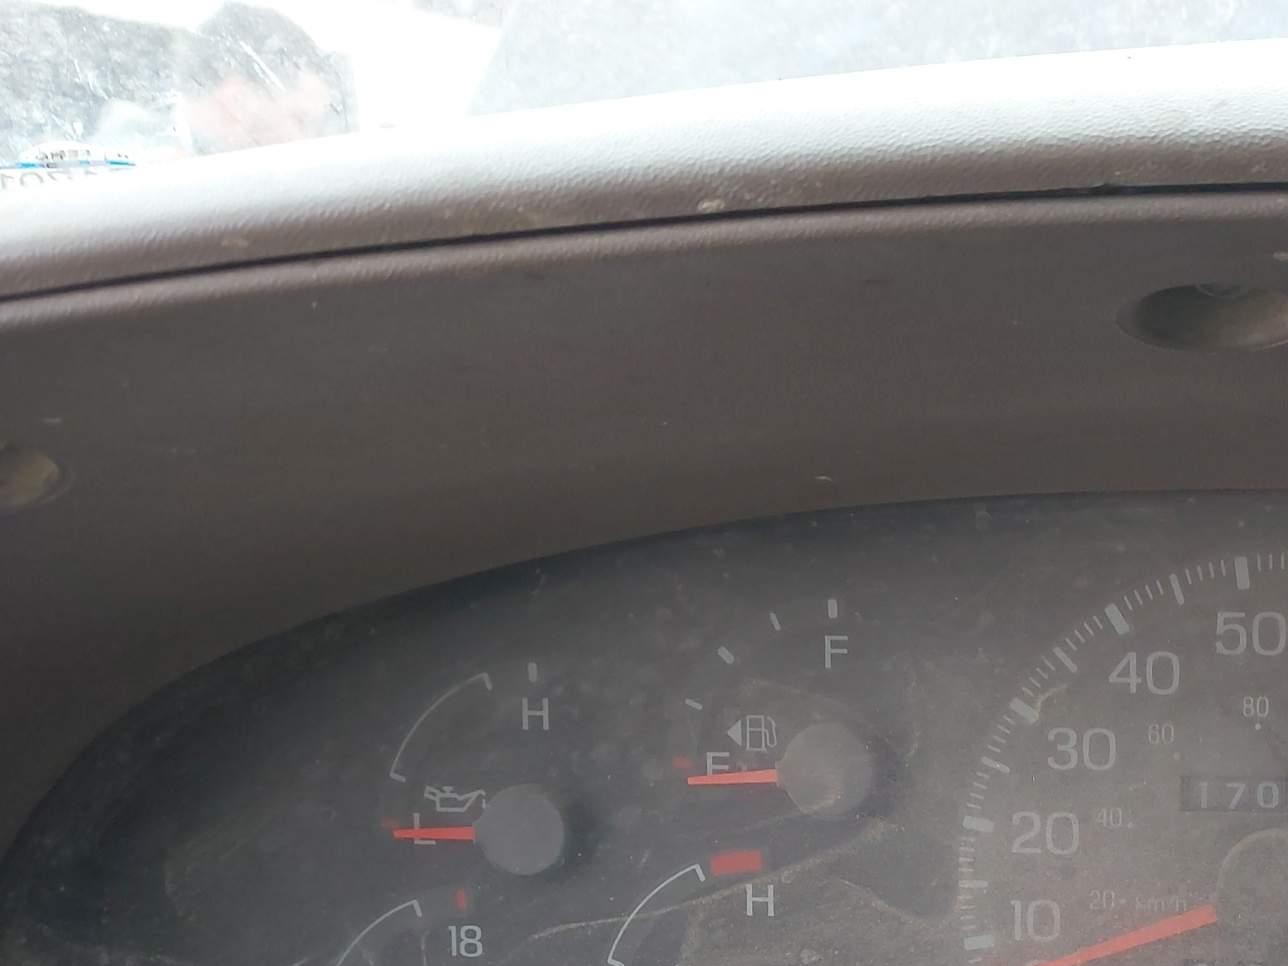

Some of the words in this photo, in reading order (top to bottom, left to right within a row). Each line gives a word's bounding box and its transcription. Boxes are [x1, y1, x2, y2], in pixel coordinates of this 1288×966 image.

[824, 634, 849, 669] F
[1215, 612, 1287, 656] 50
[1108, 650, 1180, 695] 40
[520, 696, 551, 731] H
[1241, 695, 1270, 718] 80
[1046, 726, 1116, 771] 30
[1147, 722, 1175, 745] 60
[1011, 811, 1080, 856] 20
[1096, 806, 1123, 829] 40
[745, 883, 776, 917] H
[1089, 888, 1116, 911] 20
[1010, 898, 1061, 942] 10
[447, 926, 484, 958] 18
